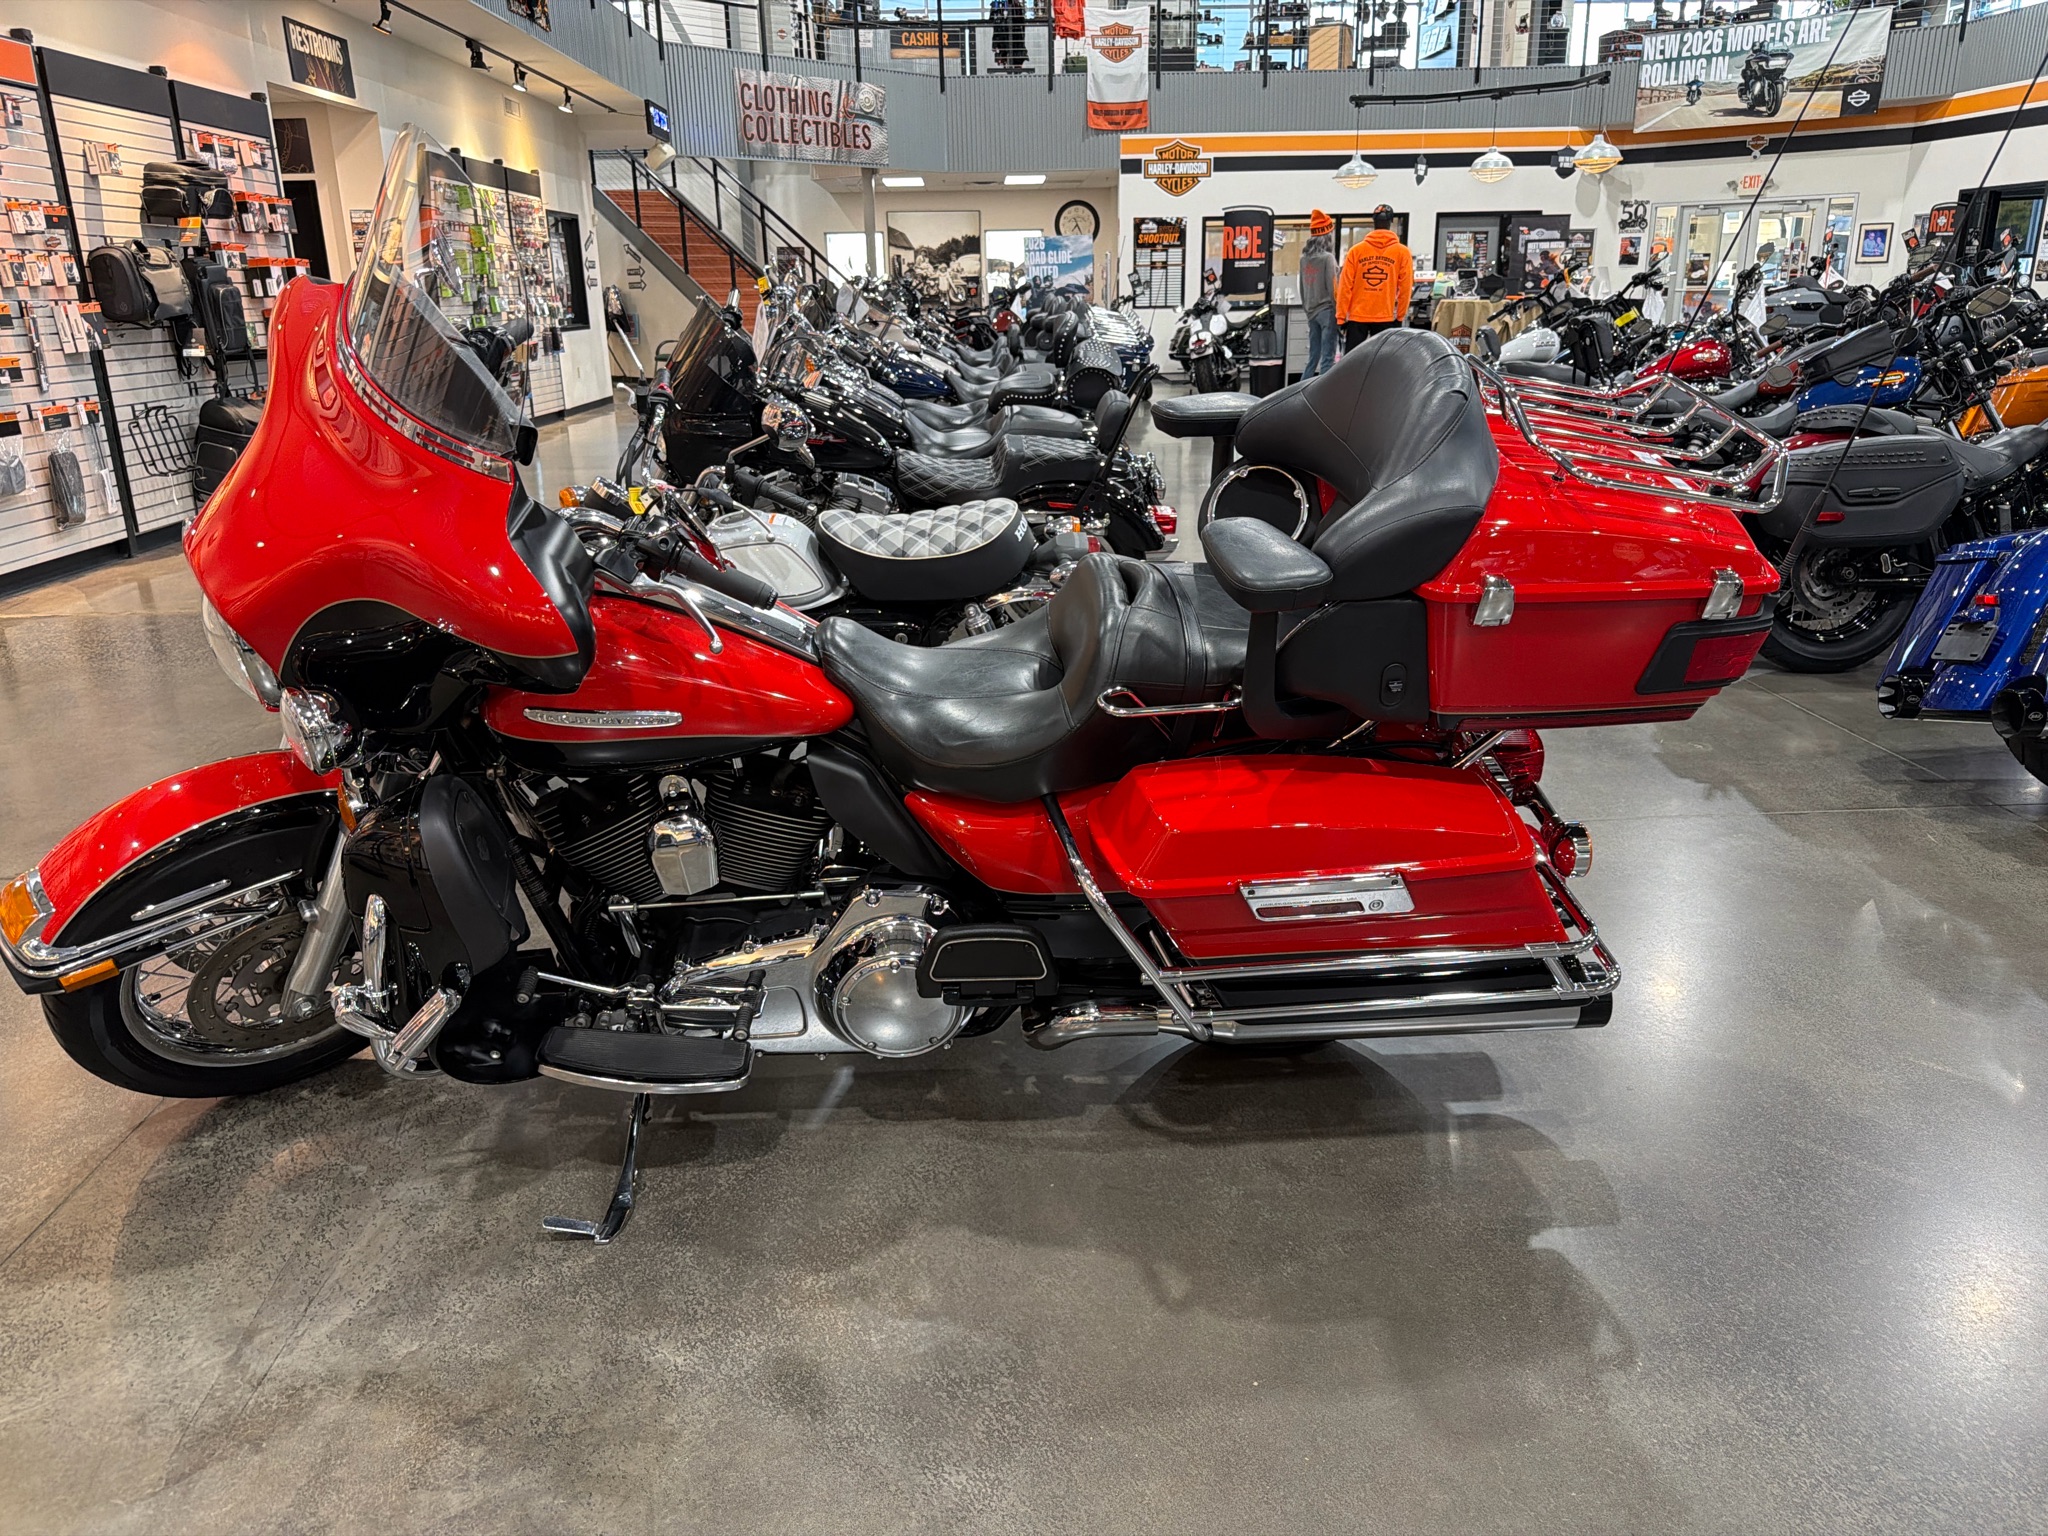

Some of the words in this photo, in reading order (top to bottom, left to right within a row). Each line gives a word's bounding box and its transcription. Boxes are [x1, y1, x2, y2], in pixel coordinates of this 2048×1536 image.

[1104, 26, 1129, 35] MOTOR
[288, 22, 344, 66] RESTROOMS
[901, 31, 949, 46] CASHIER
[1643, 34, 1682, 62] NEW
[1682, 28, 1724, 58] 2026
[1726, 20, 1795, 53] MODELS
[1797, 16, 1834, 45] ARE
[1104, 48, 1129, 60] CYCLES
[1639, 57, 1707, 88] ROLLING
[1710, 56, 1733, 82] IN.
[740, 83, 833, 118] CLOTHING
[838, 94, 856, 120] &
[742, 114, 872, 150] COLLECTIBLES
[1162, 147, 1194, 159] MOTOR
[1147, 161, 1207, 175] HARLEY-DAVIDSON
[1161, 177, 1194, 193] CYCLES
[1742, 174, 1762, 189] EXIT
[1024, 237, 1046, 251] 2026
[1138, 233, 1180, 244] SHOOTOUT
[1024, 251, 1046, 266] ROAD
[1047, 250, 1073, 264] GLIDE
